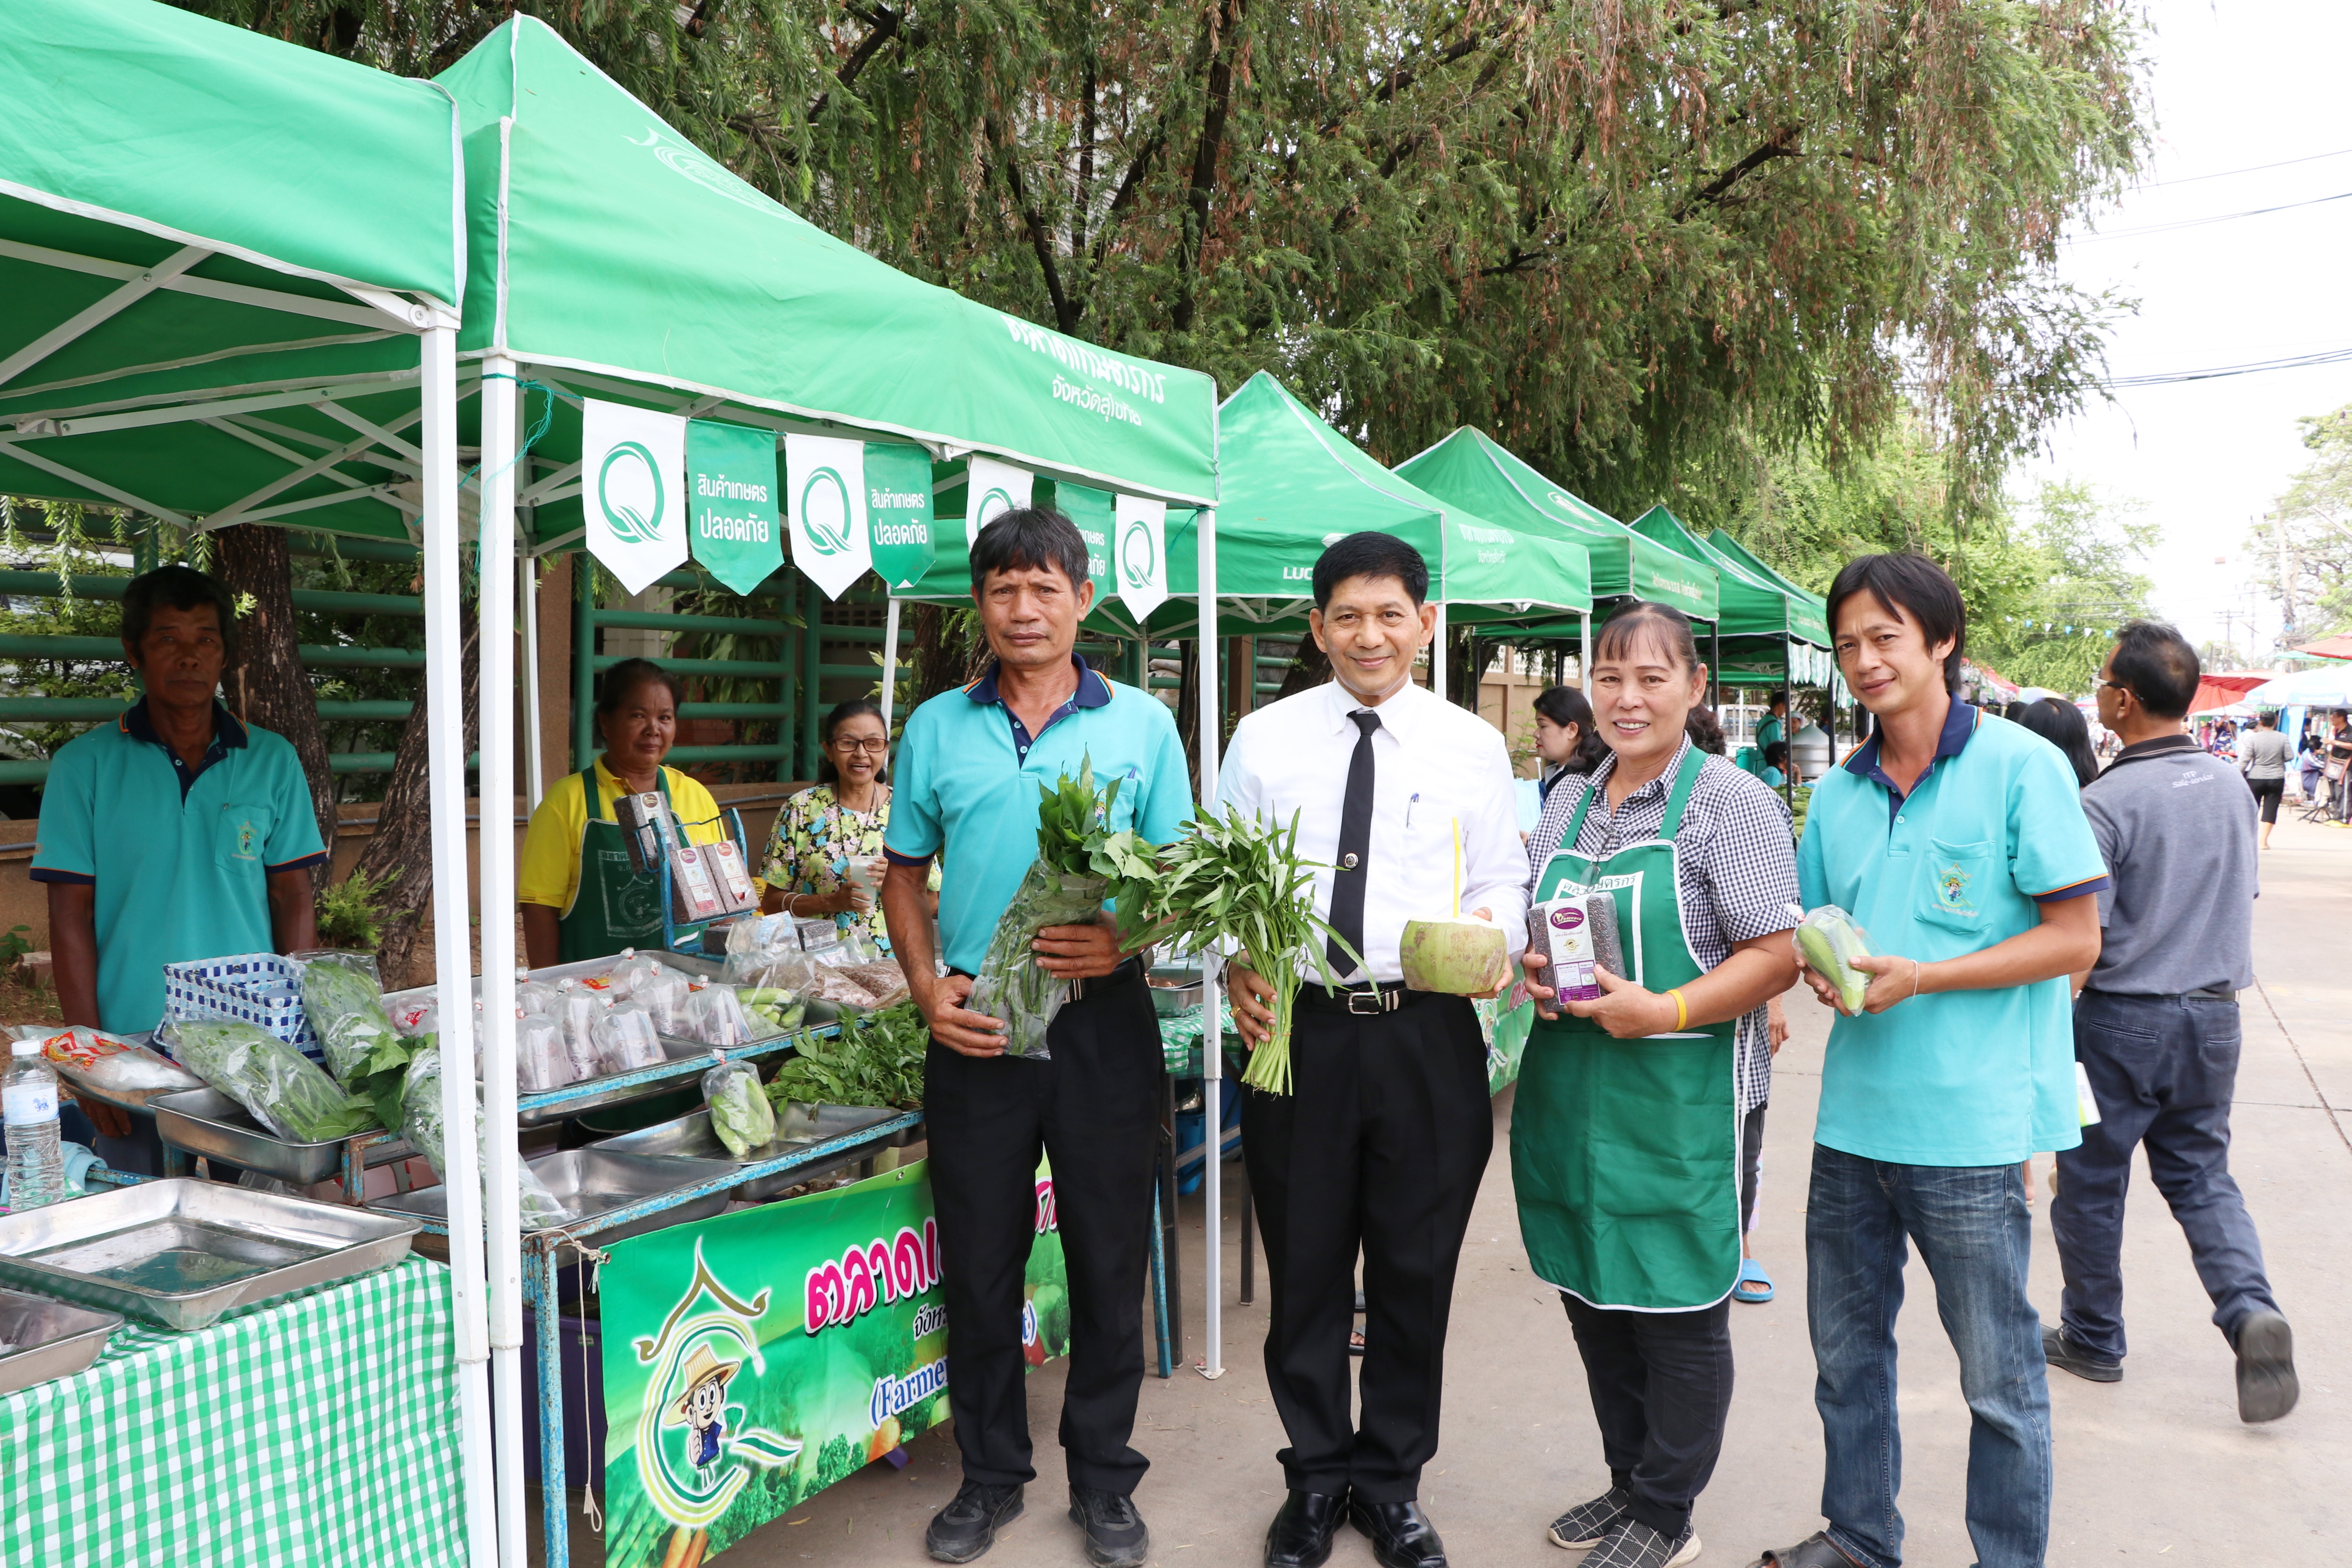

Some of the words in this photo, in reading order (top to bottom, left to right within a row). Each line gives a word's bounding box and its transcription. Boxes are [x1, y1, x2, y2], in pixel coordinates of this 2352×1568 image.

[1000, 314, 1167, 404] ตลาดเกษตรกร
[697, 473, 768, 503] สินค้าเกษตร
[871, 487, 925, 509] สินค้าเกษตร
[700, 507, 769, 543] ปลอดภัย
[873, 518, 928, 546] ปลอดภัย
[1283, 566, 1314, 581] LUC
[805, 1217, 942, 1333] ตลาดเ
